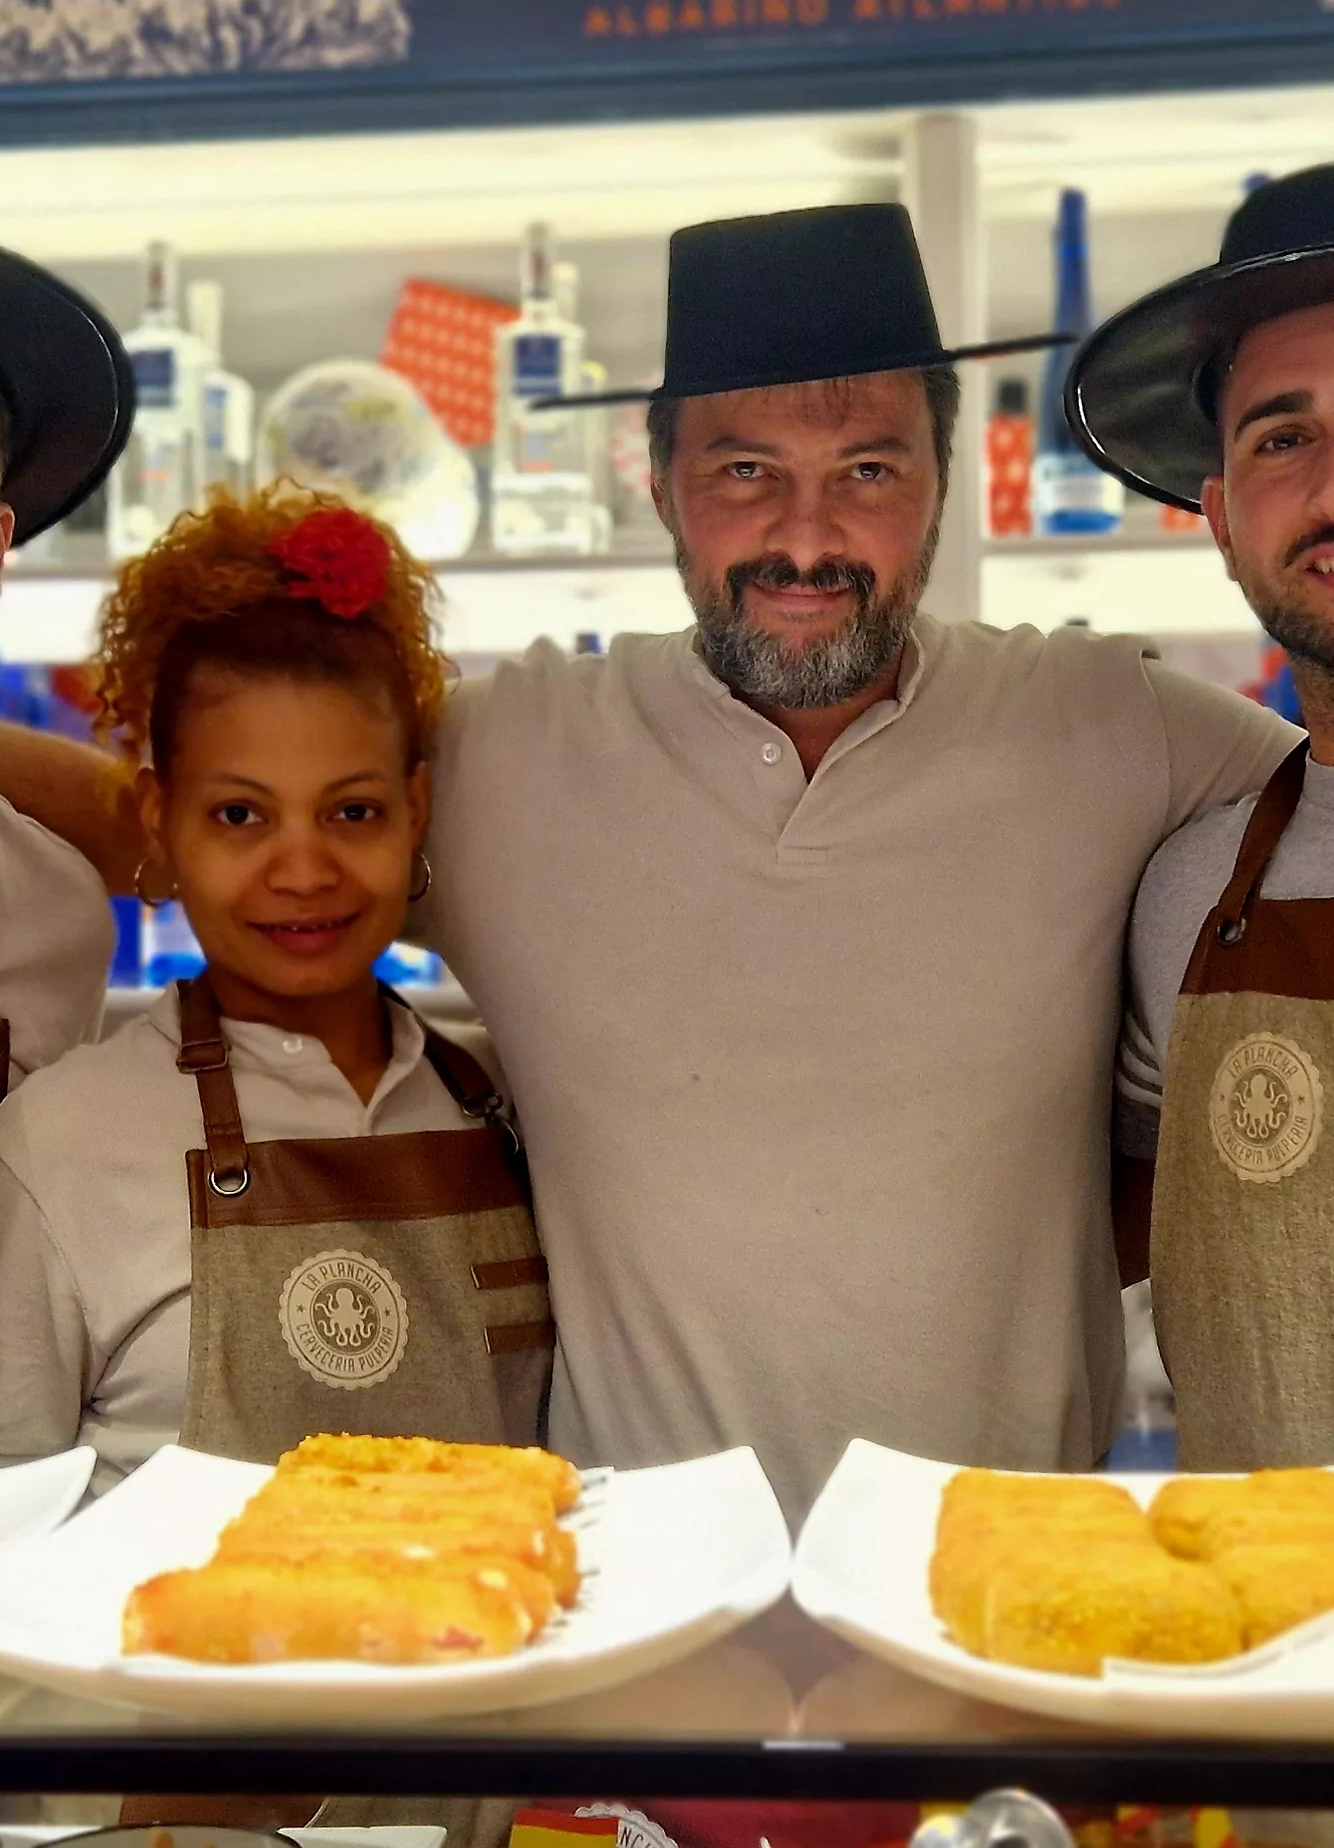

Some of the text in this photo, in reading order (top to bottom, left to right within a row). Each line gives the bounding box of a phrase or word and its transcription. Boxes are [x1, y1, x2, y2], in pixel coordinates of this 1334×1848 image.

[1227, 1046, 1299, 1080] LA PLANCHA
[301, 1261, 383, 1295] LA PLANCHA
[296, 1323, 394, 1373] CERVECERIA PULPERIA
